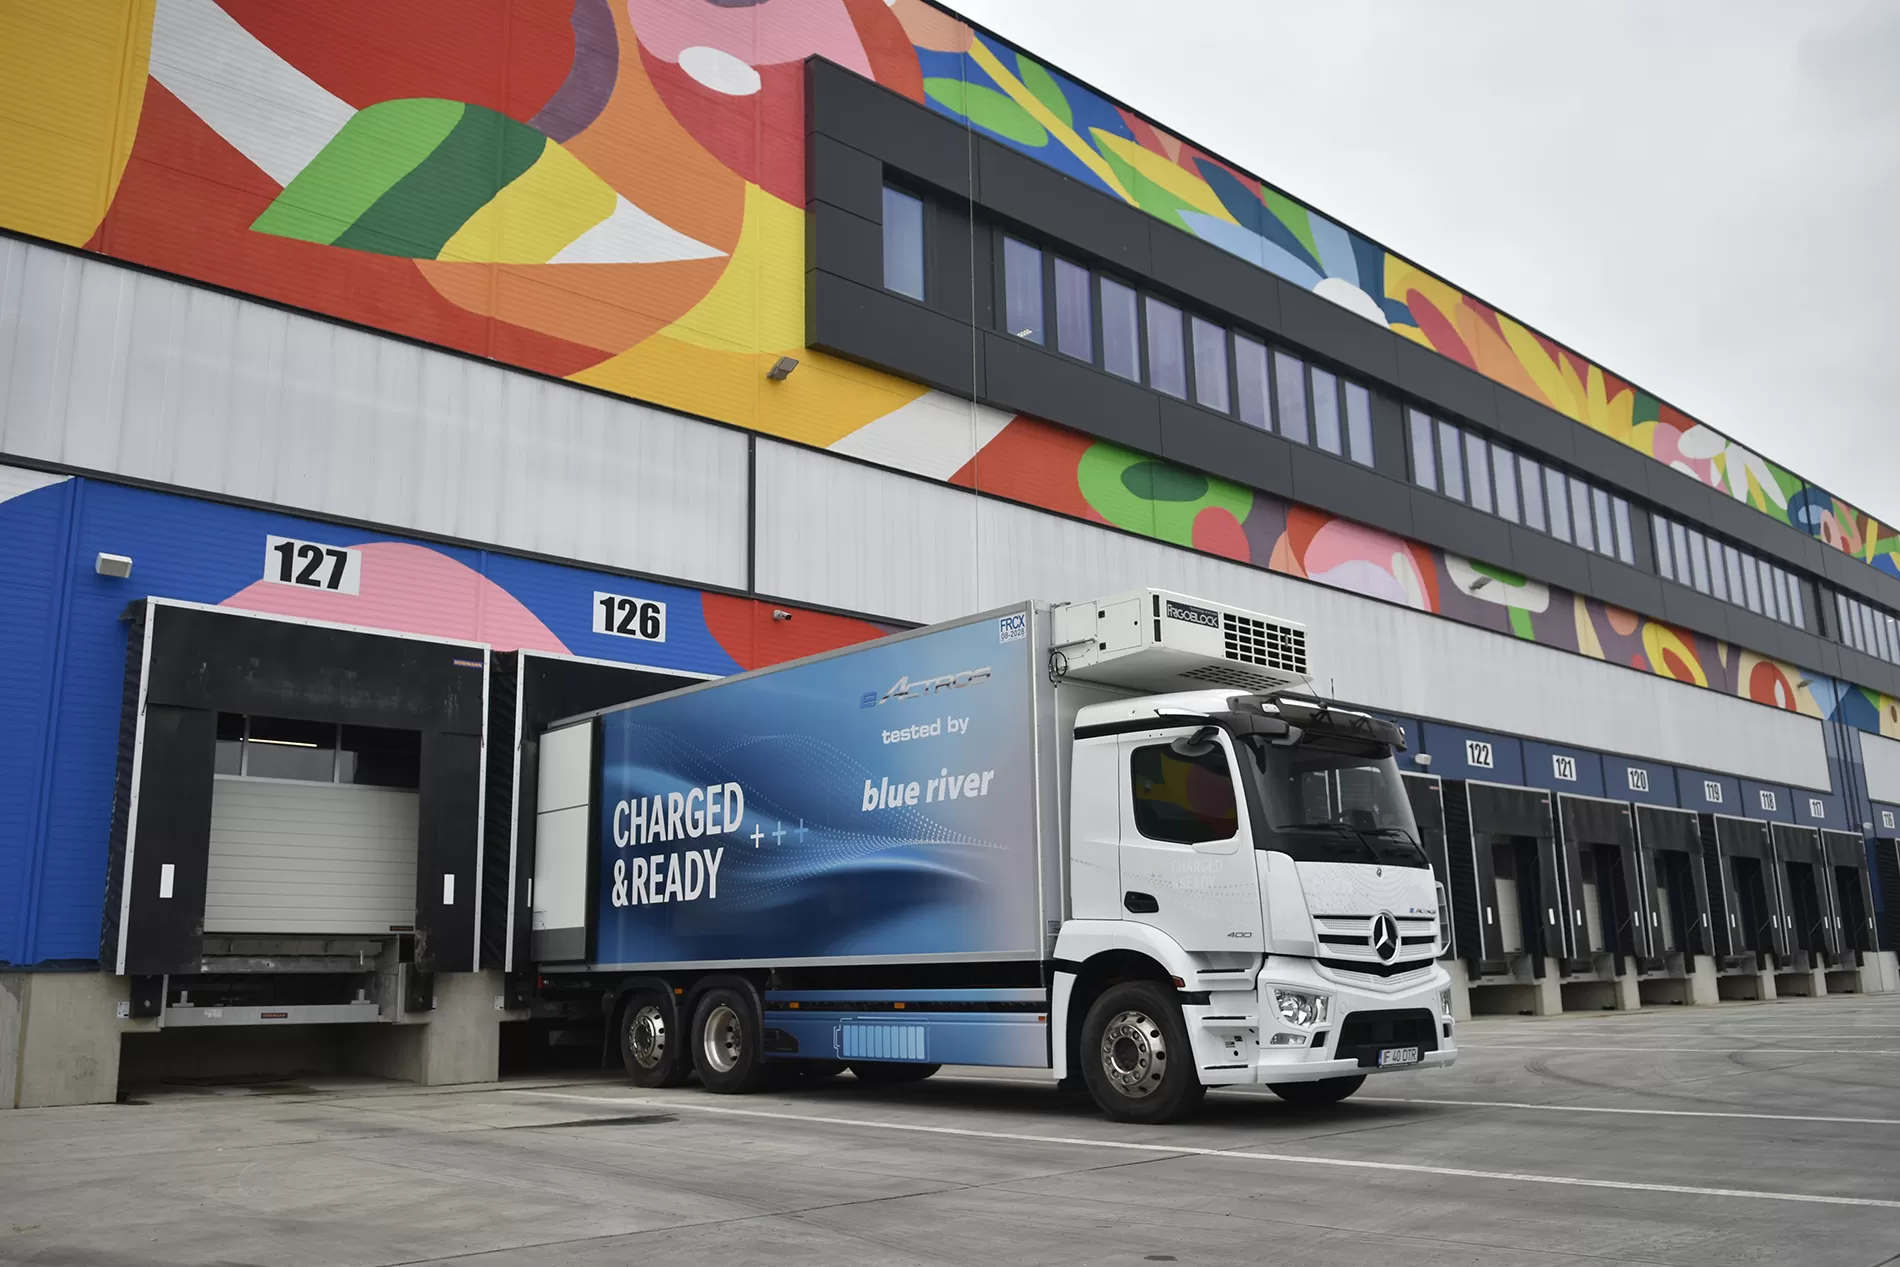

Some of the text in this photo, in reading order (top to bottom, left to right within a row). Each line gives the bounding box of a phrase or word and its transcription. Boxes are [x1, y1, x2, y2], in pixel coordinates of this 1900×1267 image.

[274, 541, 348, 590] 127
[599, 596, 661, 639] 126
[1000, 614, 1025, 632] FRCX
[882, 716, 970, 744] tested by
[1468, 743, 1491, 766] 122
[1556, 758, 1574, 778] 121
[862, 767, 995, 811] blue river
[1630, 770, 1647, 790] 120
[1706, 783, 1720, 801] 119
[1762, 793, 1774, 810] 118
[613, 782, 745, 848] CHARGED
[1811, 801, 1822, 817] 117
